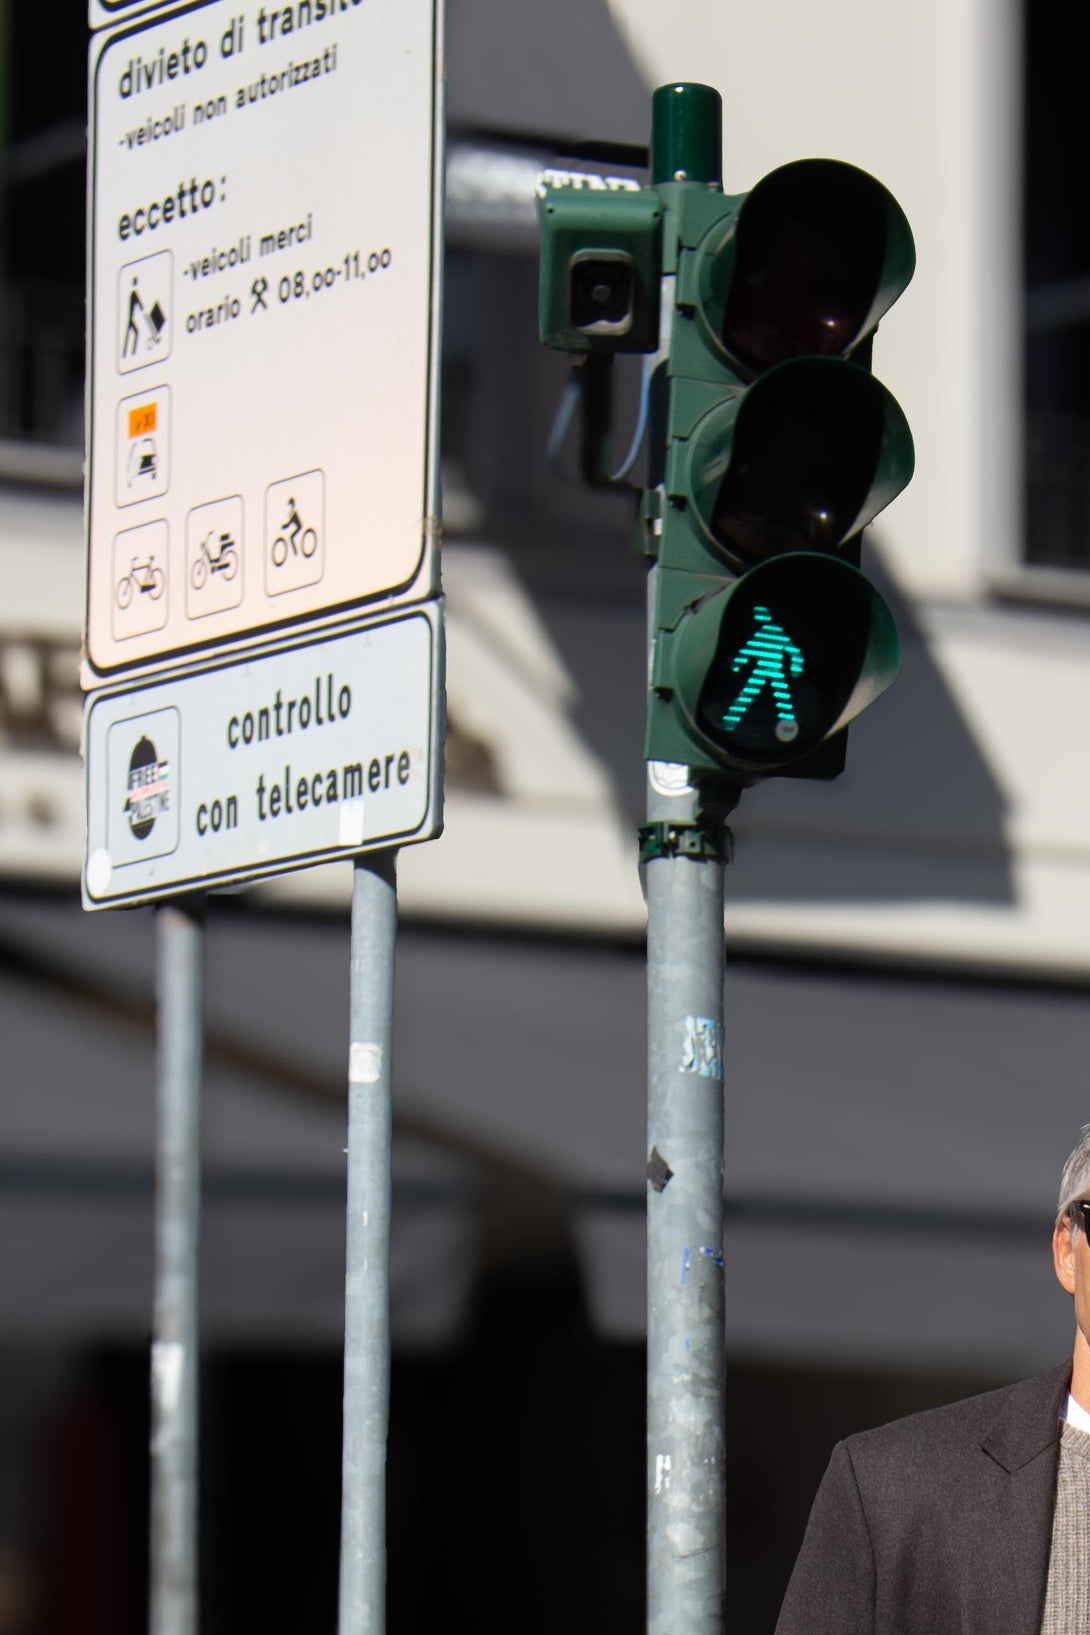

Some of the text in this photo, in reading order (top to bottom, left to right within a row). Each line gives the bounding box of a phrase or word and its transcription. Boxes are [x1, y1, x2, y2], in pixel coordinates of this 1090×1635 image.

[119, 0, 362, 99] divieto di trans
[193, 93, 227, 126] non
[236, 44, 338, 109] autorizzati
[119, 176, 227, 241] eccetto:
[260, 213, 313, 256] merci
[186, 295, 241, 334] orario
[228, 673, 352, 749] controllo
[196, 751, 411, 837] con telecamere
